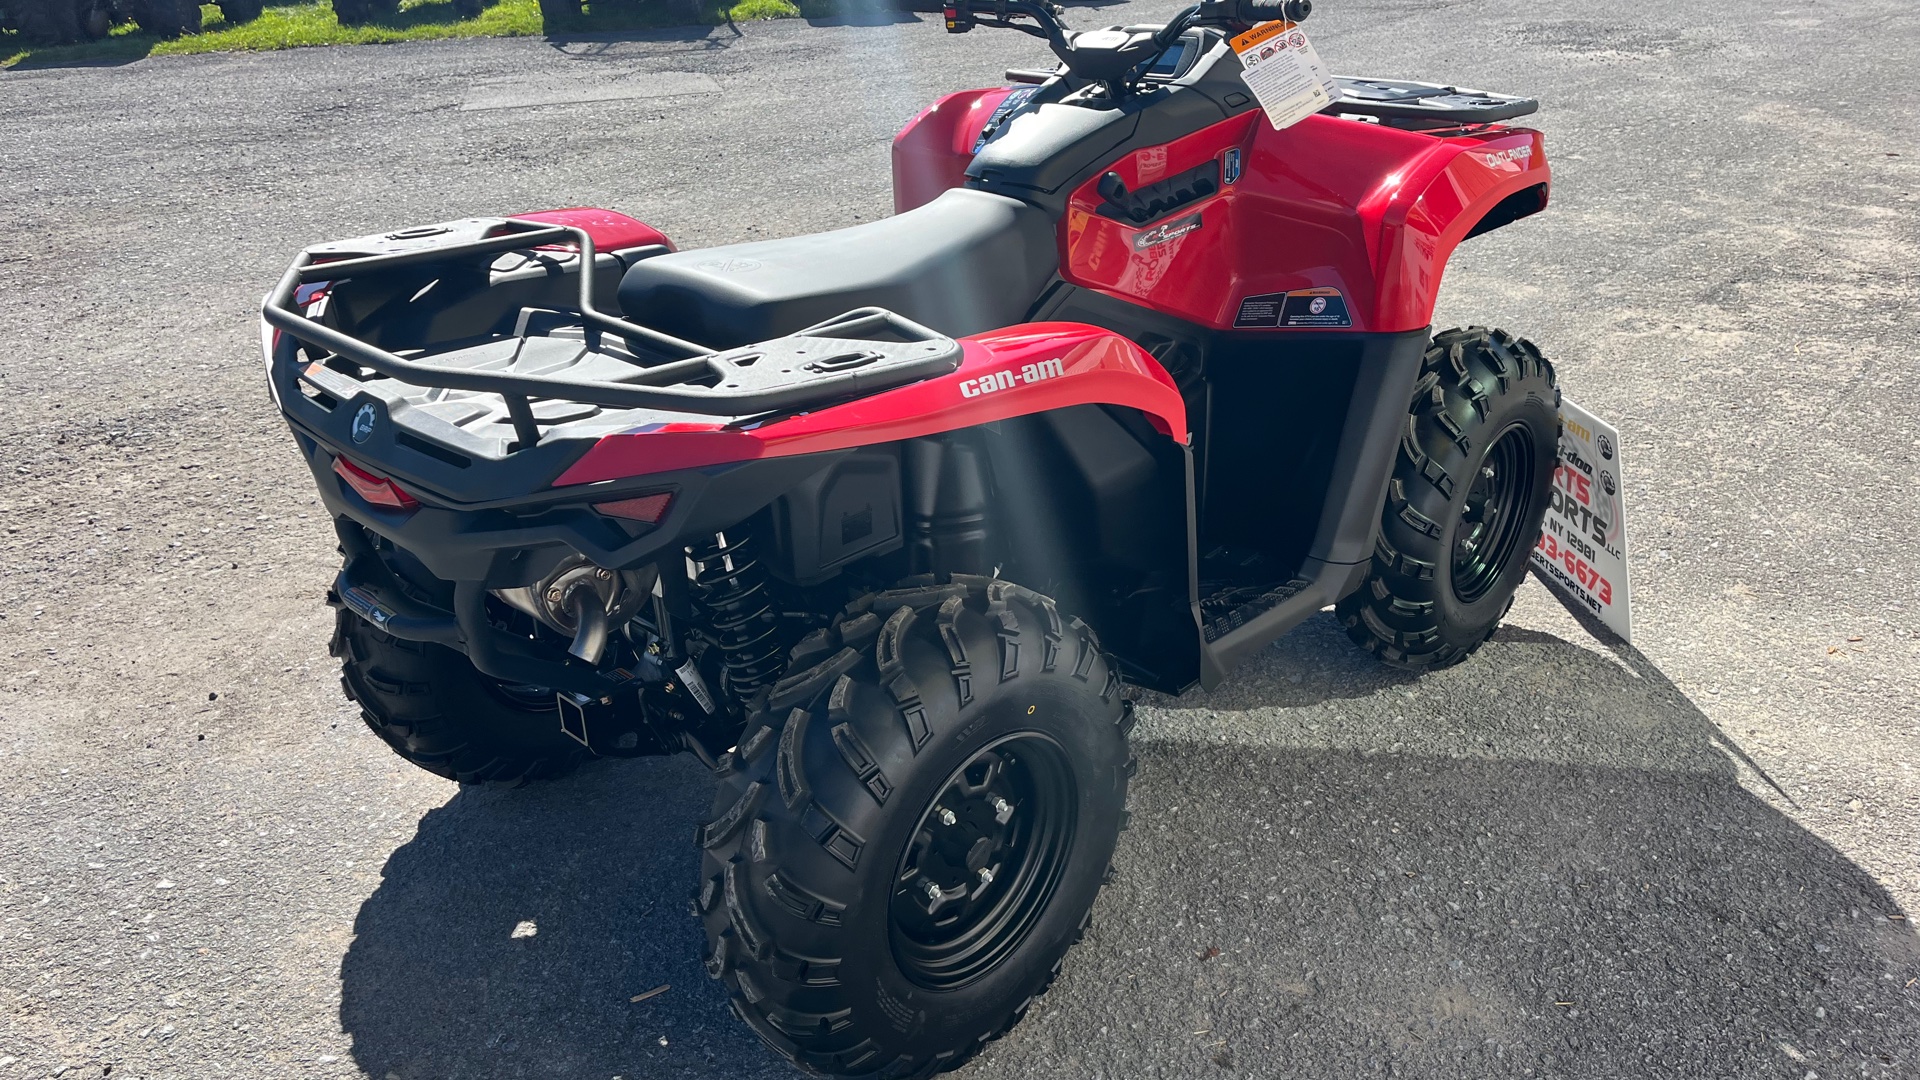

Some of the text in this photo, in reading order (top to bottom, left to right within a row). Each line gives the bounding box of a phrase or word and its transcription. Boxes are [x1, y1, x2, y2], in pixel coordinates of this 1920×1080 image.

[1486, 145, 1532, 168] OUTLANDER
[959, 358, 1064, 399] can-am
[1550, 517, 1596, 563] NY 12981
